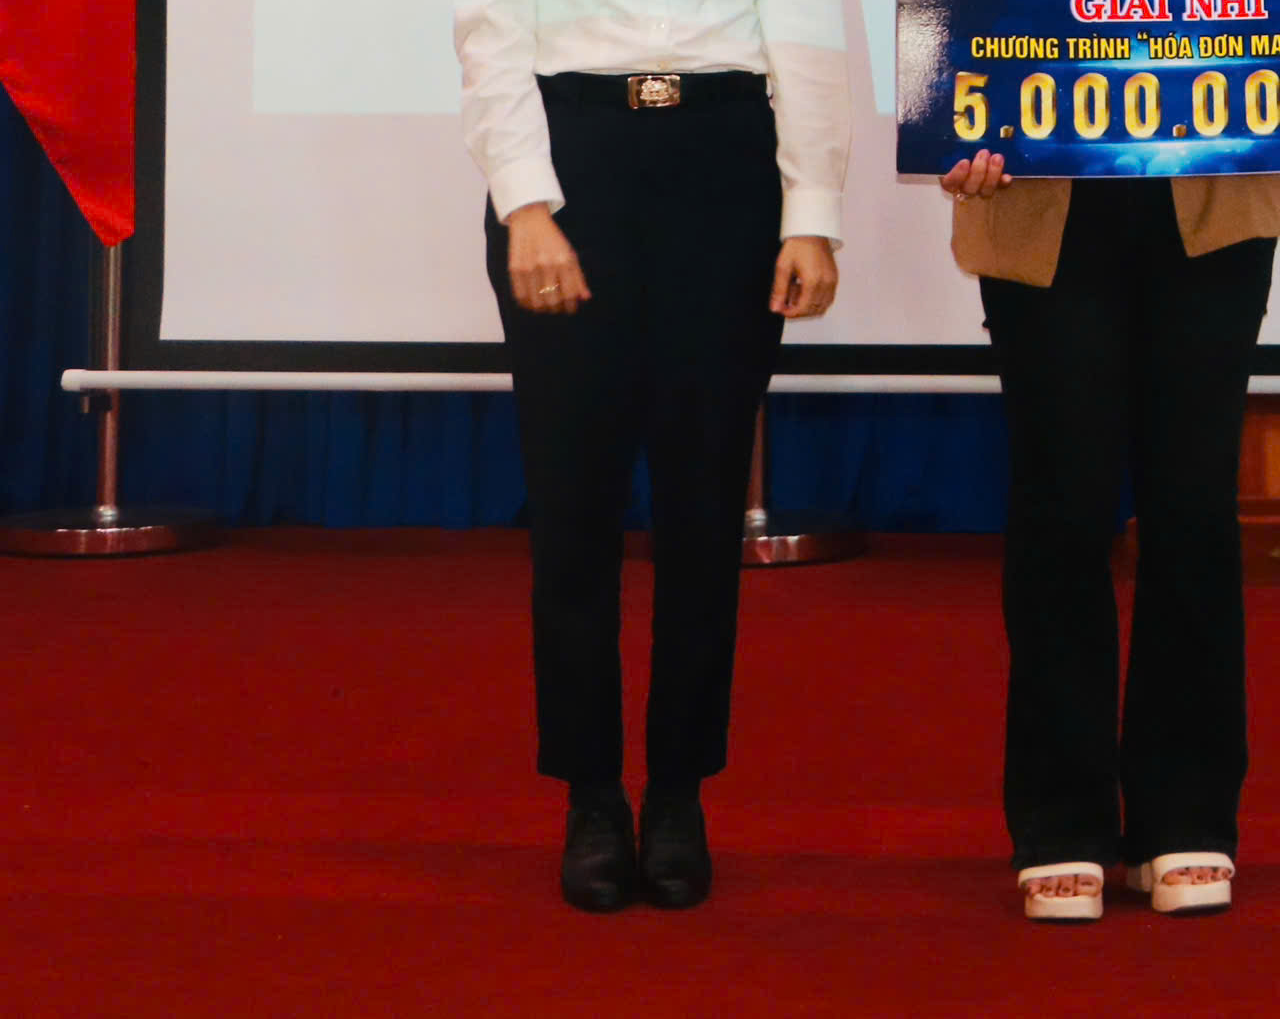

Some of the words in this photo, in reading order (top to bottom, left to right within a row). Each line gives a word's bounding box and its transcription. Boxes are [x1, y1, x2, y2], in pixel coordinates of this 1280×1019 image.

[971, 36, 1059, 60] CHƯƠNG
[1066, 33, 1131, 59] TRÌNH
[1136, 30, 1194, 59] “HÓA
[1199, 34, 1244, 59] ĐƠN
